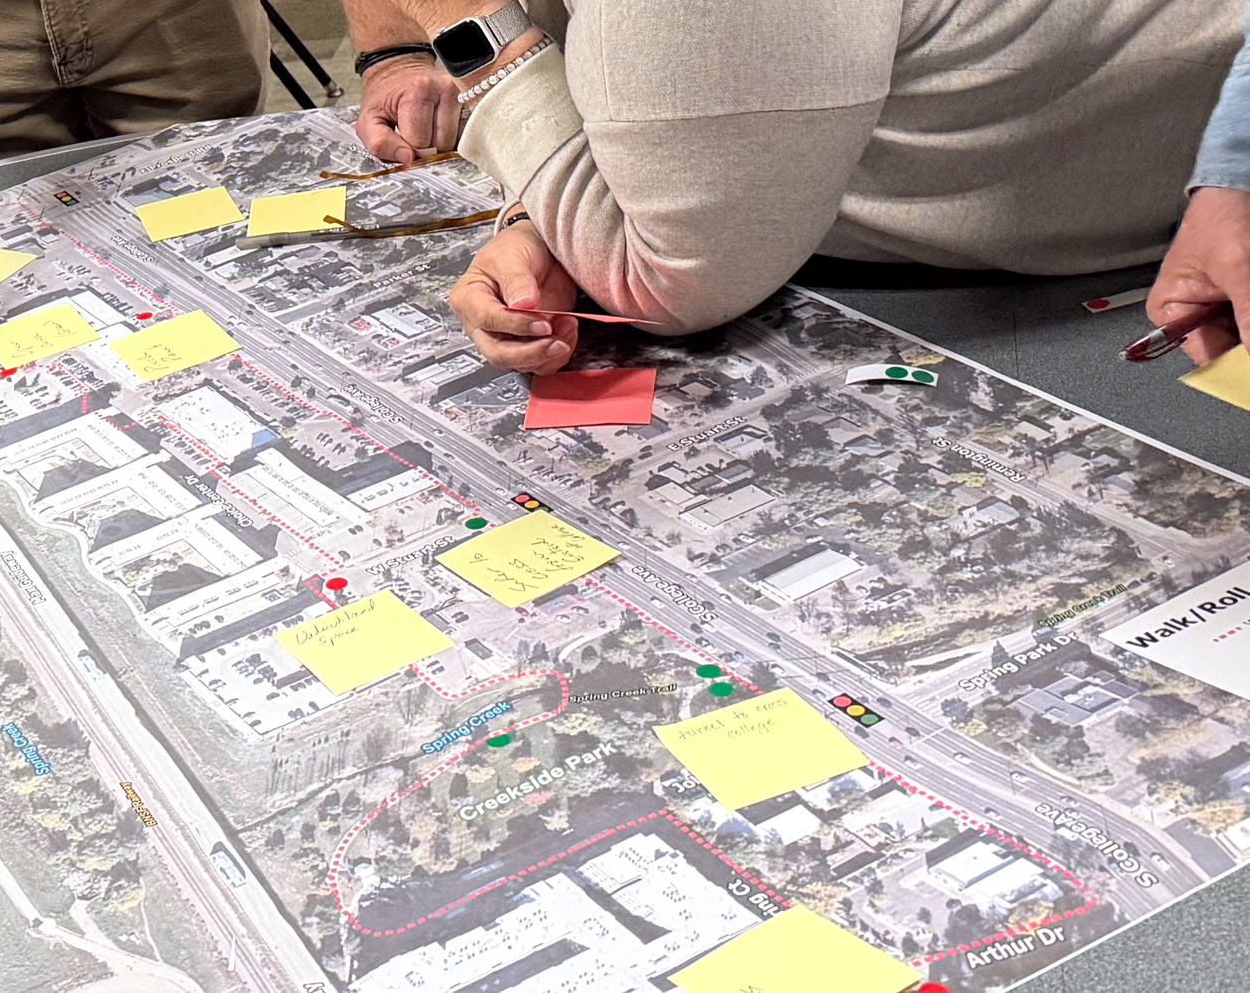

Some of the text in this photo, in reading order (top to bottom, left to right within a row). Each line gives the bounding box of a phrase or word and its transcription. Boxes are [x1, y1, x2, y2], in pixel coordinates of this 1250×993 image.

[372, 263, 432, 289] Parker St
[388, 415, 405, 425] S
[666, 415, 748, 452] E Stuart St
[183, 474, 200, 486] Dr
[931, 436, 1026, 483] Remington St
[365, 535, 457, 576] W Stuart St
[631, 566, 719, 622] S College Ave
[1125, 586, 1250, 649] Walk/Roll
[958, 630, 1079, 692] Spring Park Dr
[569, 683, 678, 705] Spring Creek Trail
[420, 700, 512, 755] Spring Creek
[679, 698, 788, 740] tunnel to cross
[727, 718, 775, 740] college
[0, 721, 52, 777] Spring Creek
[458, 741, 618, 822] Creekside Park
[1034, 802, 1160, 889] S College Ave
[728, 878, 751, 897] Ct
[966, 926, 1066, 970] Arthur Dr
